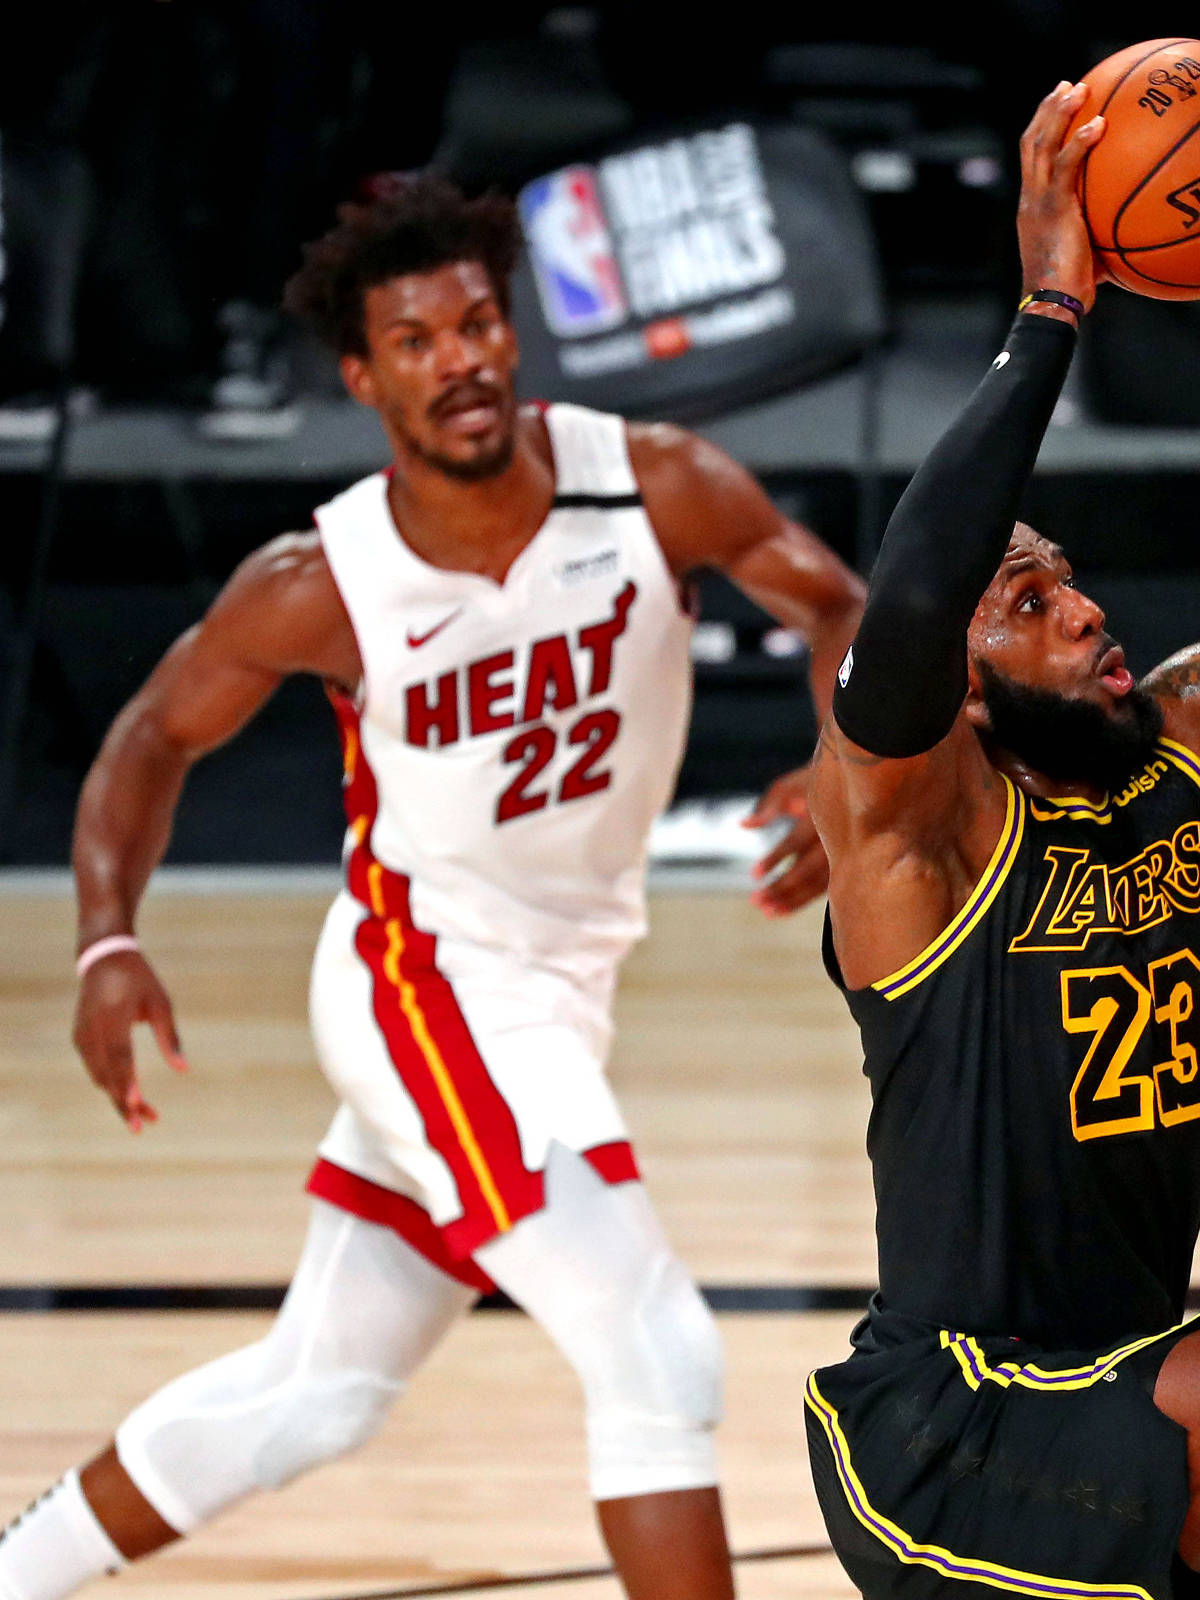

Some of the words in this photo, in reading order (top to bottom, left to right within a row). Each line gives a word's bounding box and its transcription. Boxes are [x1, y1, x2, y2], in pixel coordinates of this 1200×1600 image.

[1138, 88, 1173, 117] 20
[405, 579, 638, 749] HEAT
[495, 708, 622, 826] 22
[1112, 760, 1169, 807] wish
